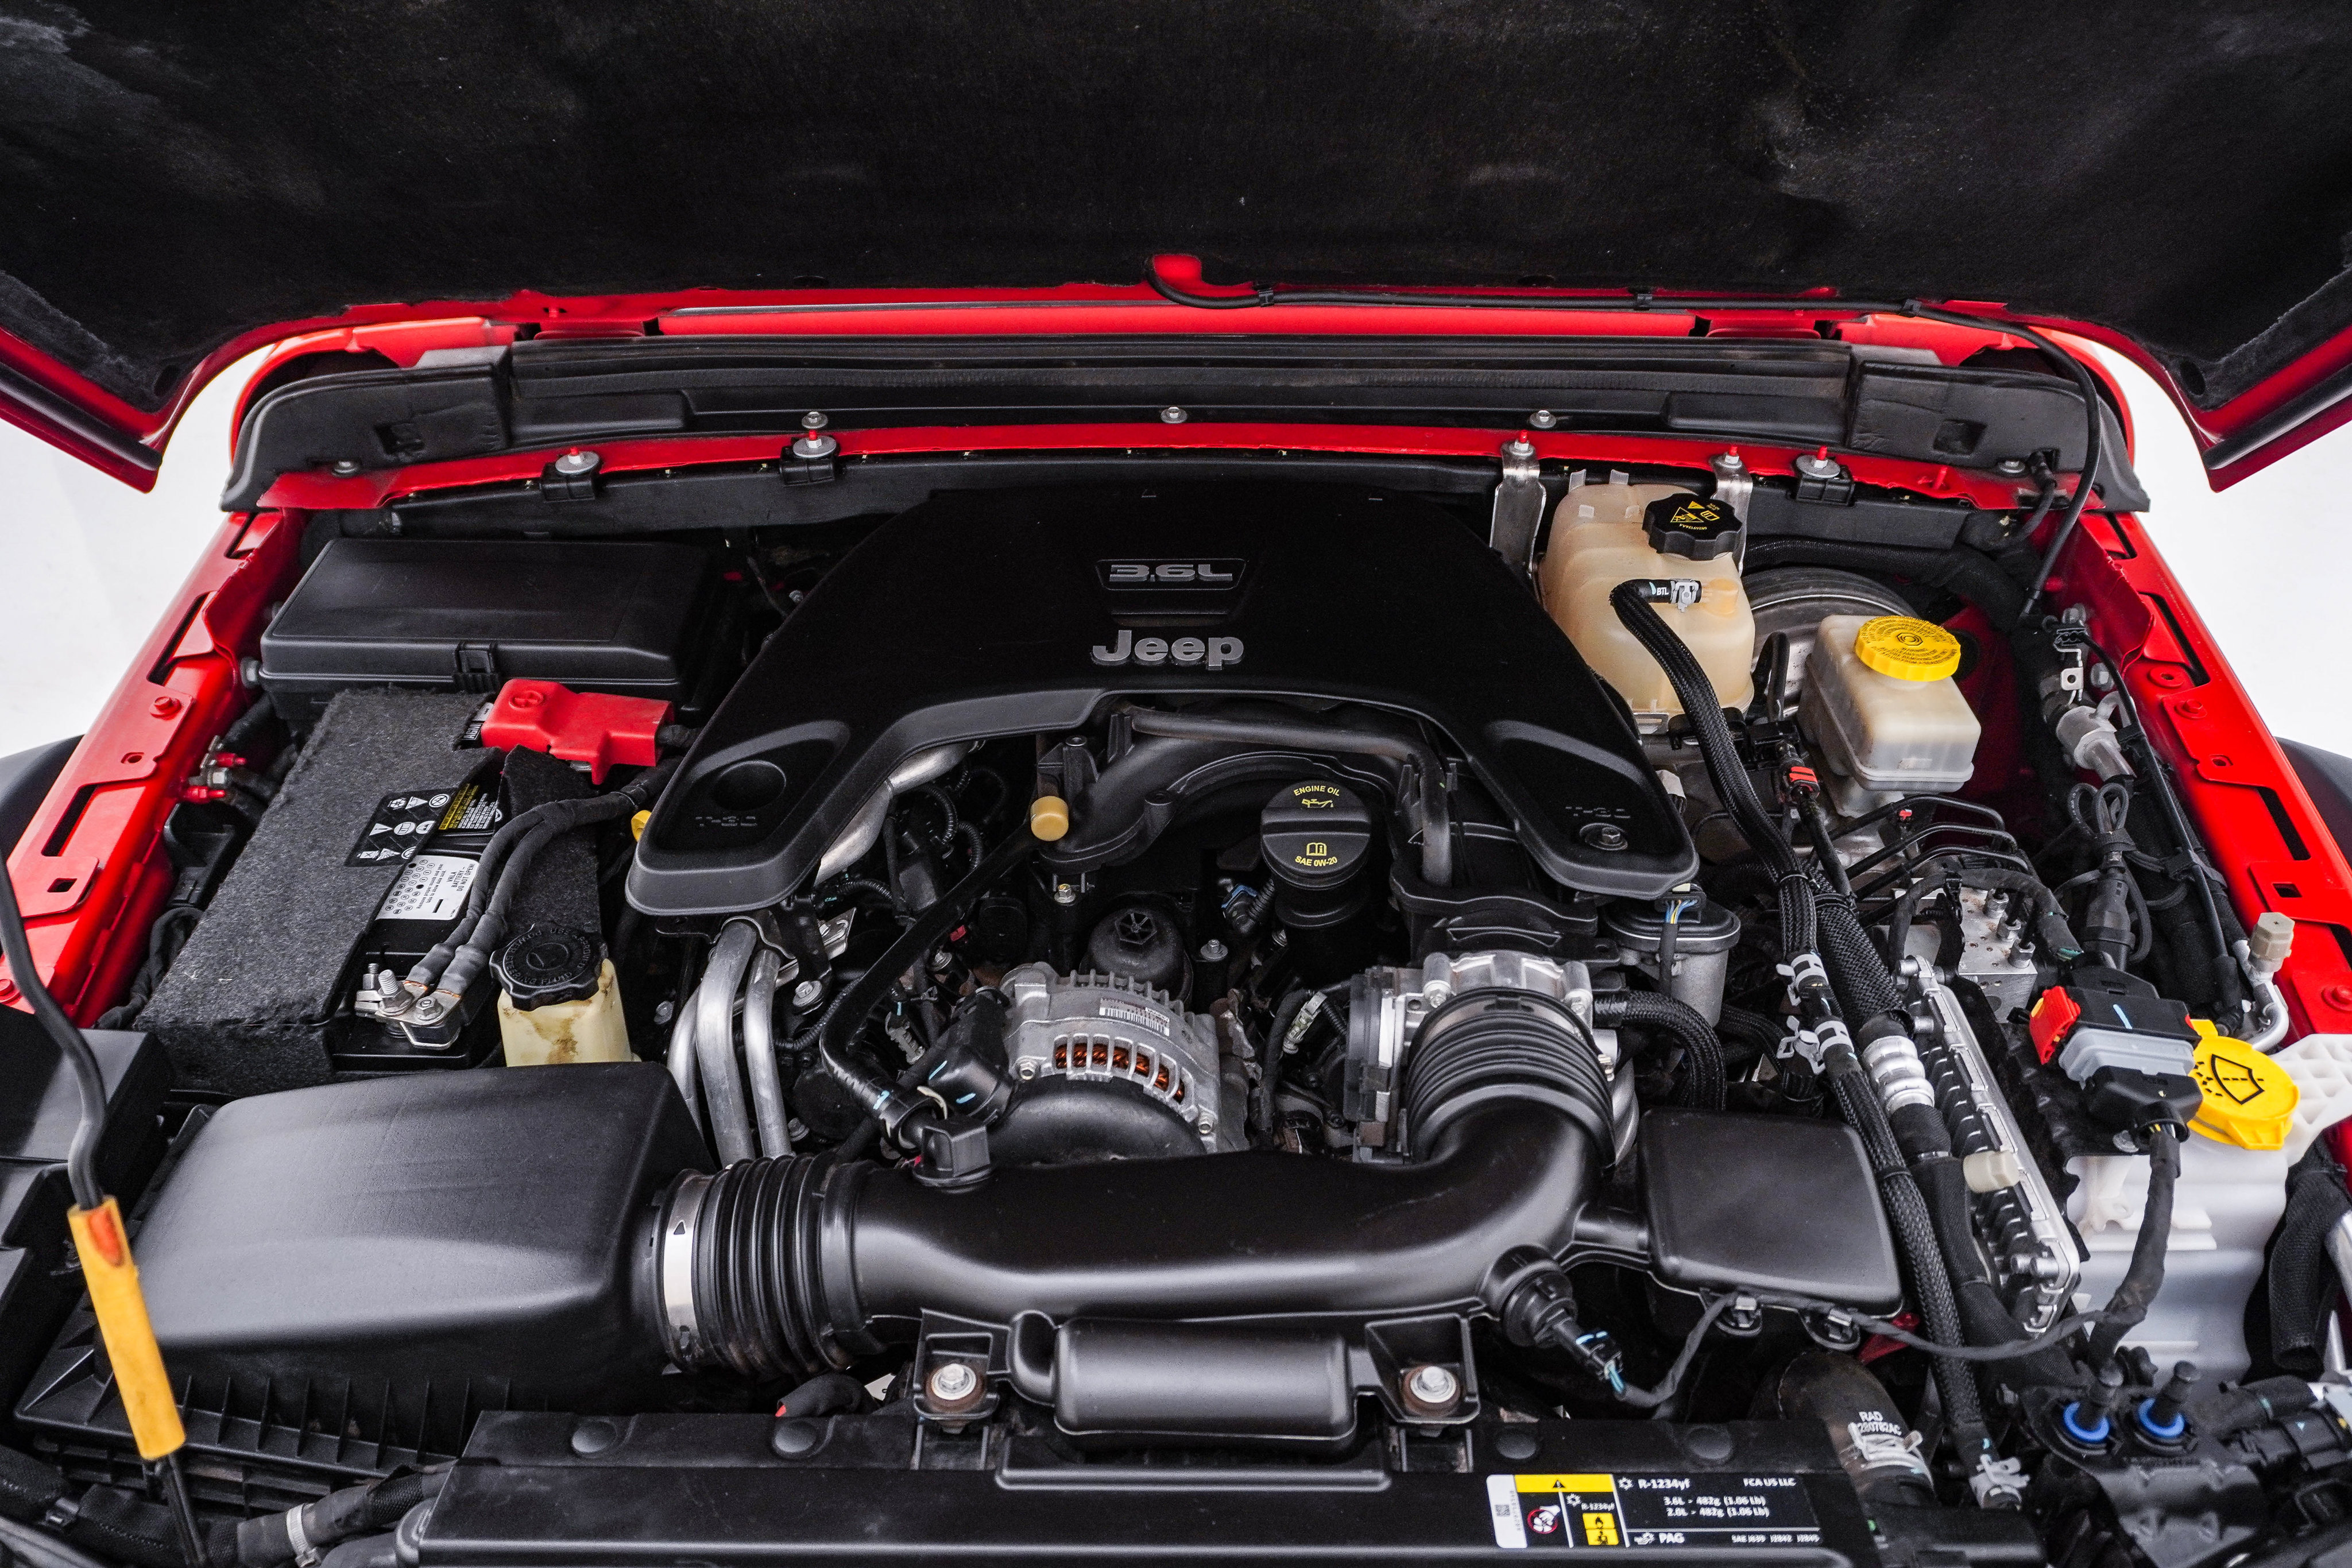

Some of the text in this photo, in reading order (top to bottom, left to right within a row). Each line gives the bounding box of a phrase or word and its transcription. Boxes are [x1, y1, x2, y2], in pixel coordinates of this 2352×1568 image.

[1109, 564, 1233, 582] 3.6L
[1657, 587, 1669, 595] BTL
[1091, 630, 1244, 671] Jeep
[1293, 785, 1341, 796] ENGINE OIL
[1295, 855, 1338, 867] SAE 0W-20
[464, 863, 475, 876] OPEN!
[446, 872, 457, 882] VRLA
[451, 870, 465, 887] BATTERY
[506, 930, 573, 985] POWER STEERING FLUID
[1858, 1411, 1883, 1422] RAD
[1638, 1478, 1690, 1490] R-1234yf
[1743, 1478, 1797, 1486] FCA US LLC
[1664, 1496, 1685, 1505] 3.6L
[1667, 1507, 1688, 1517] 2.0L
[1659, 1532, 1685, 1544] PAG
